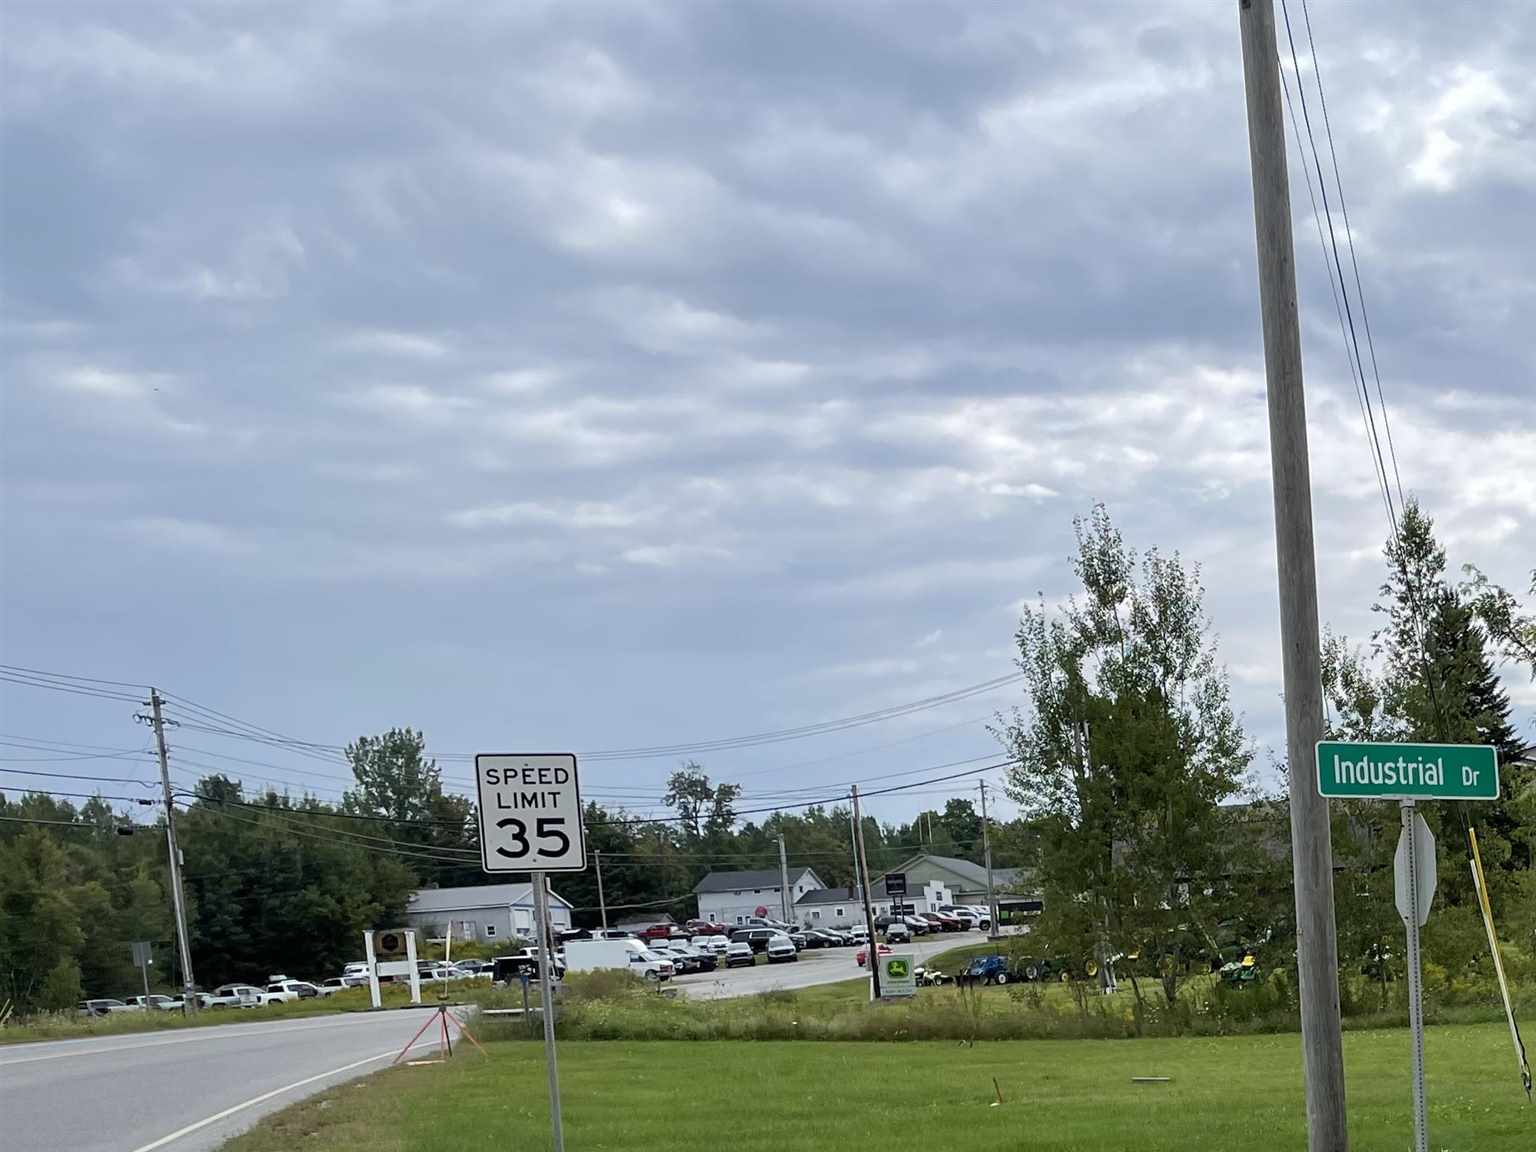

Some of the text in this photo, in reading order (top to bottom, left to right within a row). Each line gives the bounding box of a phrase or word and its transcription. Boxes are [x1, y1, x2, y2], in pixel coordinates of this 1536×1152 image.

[486, 767, 569, 786] SPEED
[1333, 754, 1481, 787] Industrial Dr
[496, 791, 561, 809] LIMIT
[495, 817, 570, 859] 35
